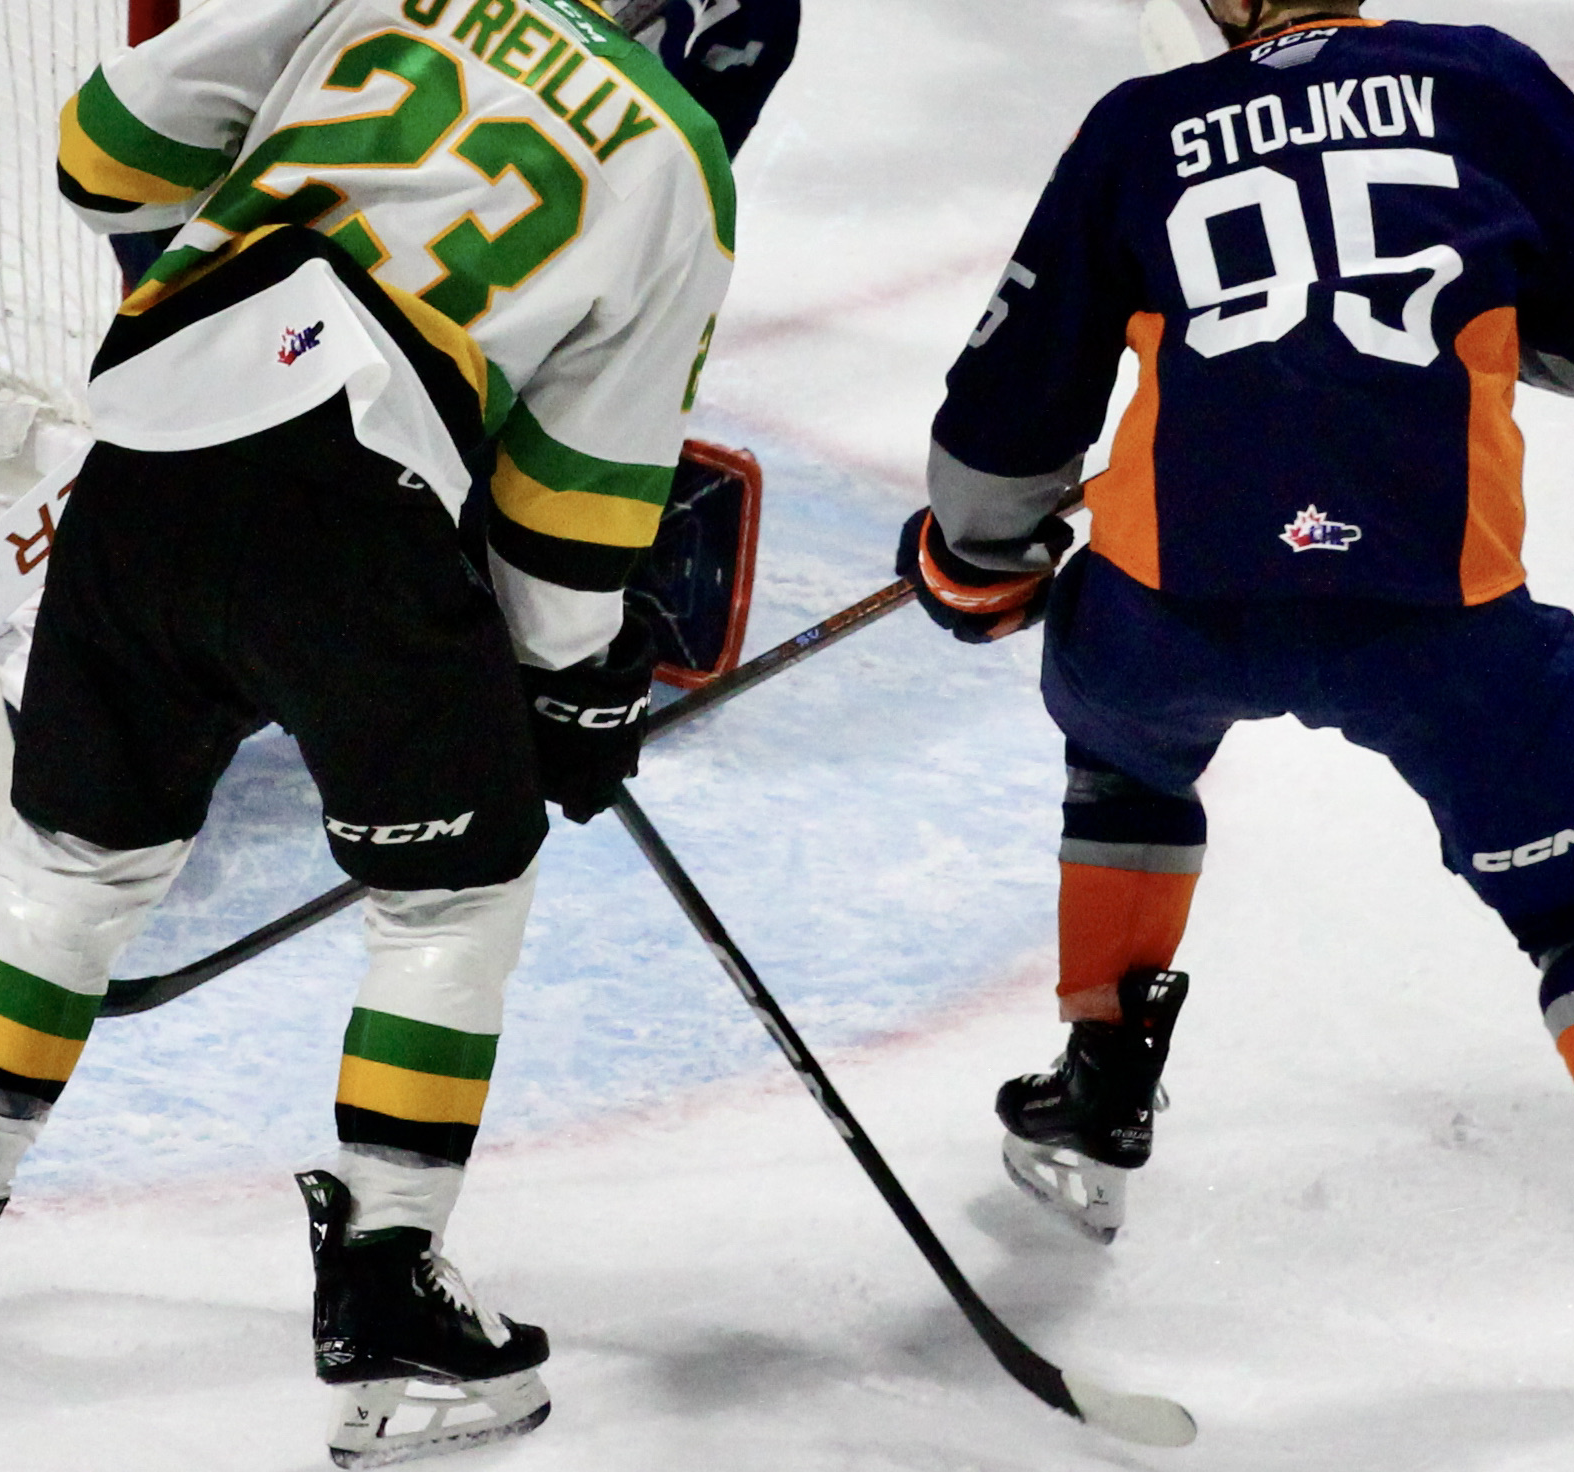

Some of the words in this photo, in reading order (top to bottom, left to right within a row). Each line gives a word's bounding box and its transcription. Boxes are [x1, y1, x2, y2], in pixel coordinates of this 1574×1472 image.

[1250, 27, 1339, 62] CCM
[1170, 74, 1435, 178] STOJKOV
[193, 28, 588, 330] 23
[1165, 147, 1464, 368] 95
[325, 810, 476, 846] CCM
